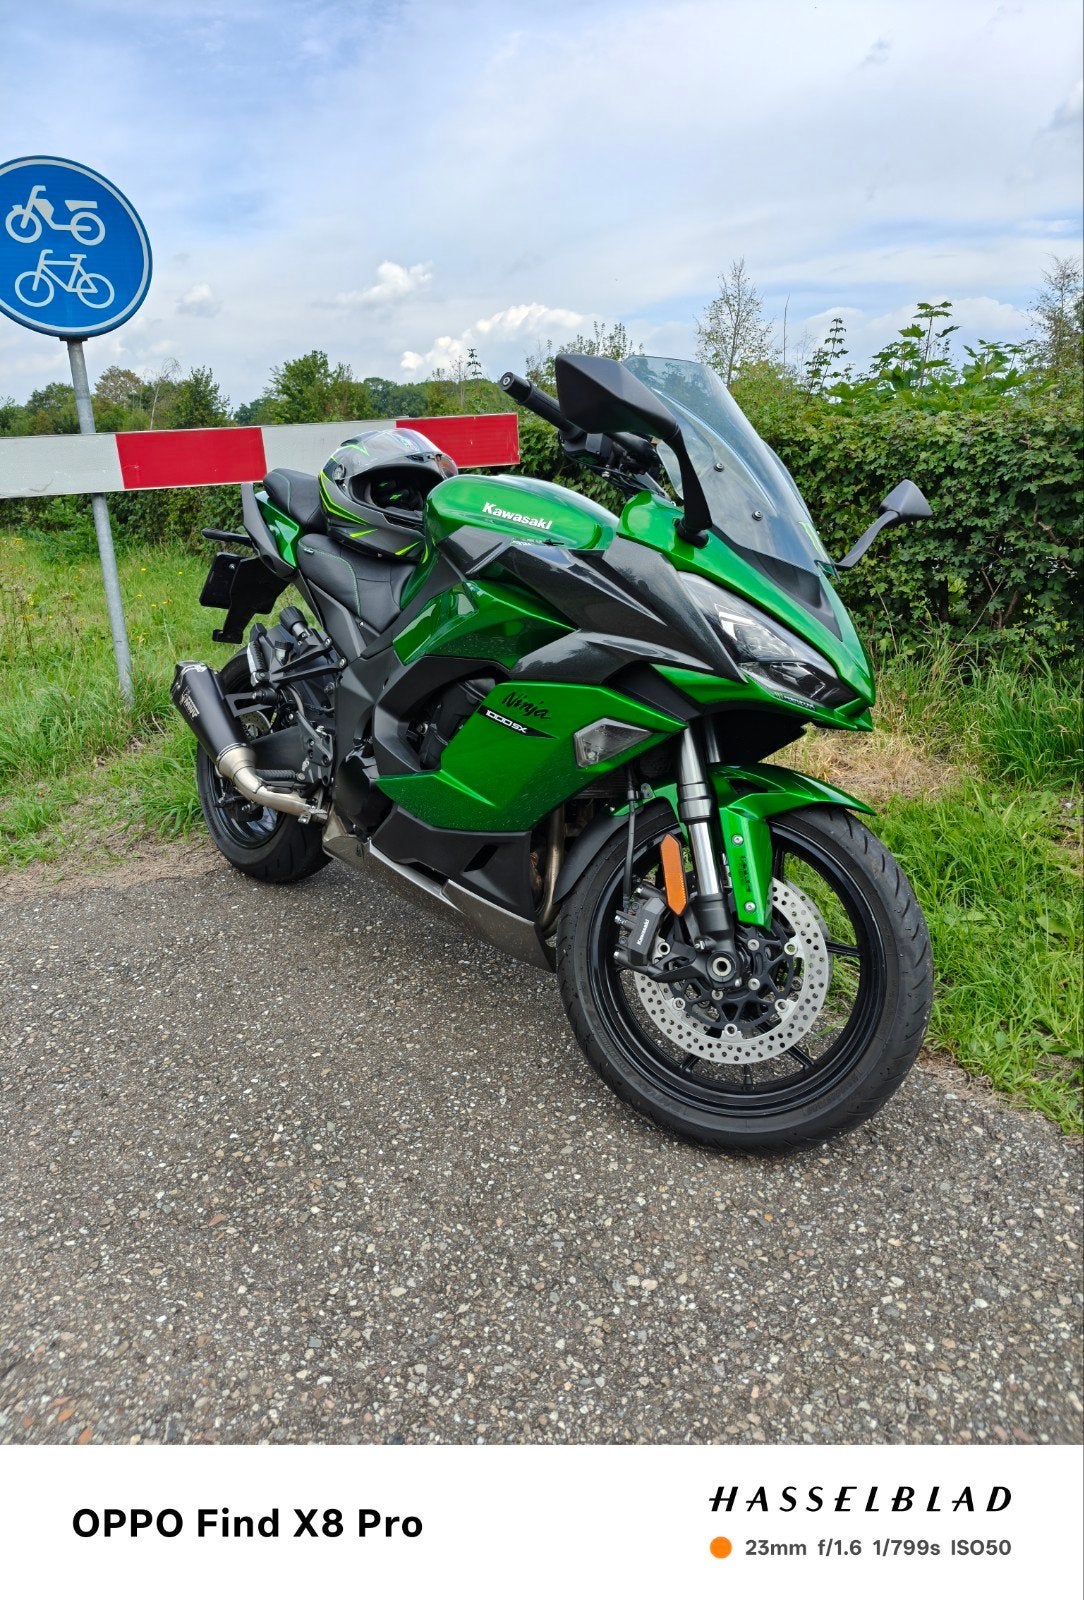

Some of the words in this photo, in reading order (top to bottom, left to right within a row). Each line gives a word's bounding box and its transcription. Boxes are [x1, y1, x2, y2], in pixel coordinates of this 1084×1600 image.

[482, 502, 553, 530] Kawasaki
[501, 691, 551, 720] Ninja
[485, 709, 528, 734] 1000SX
